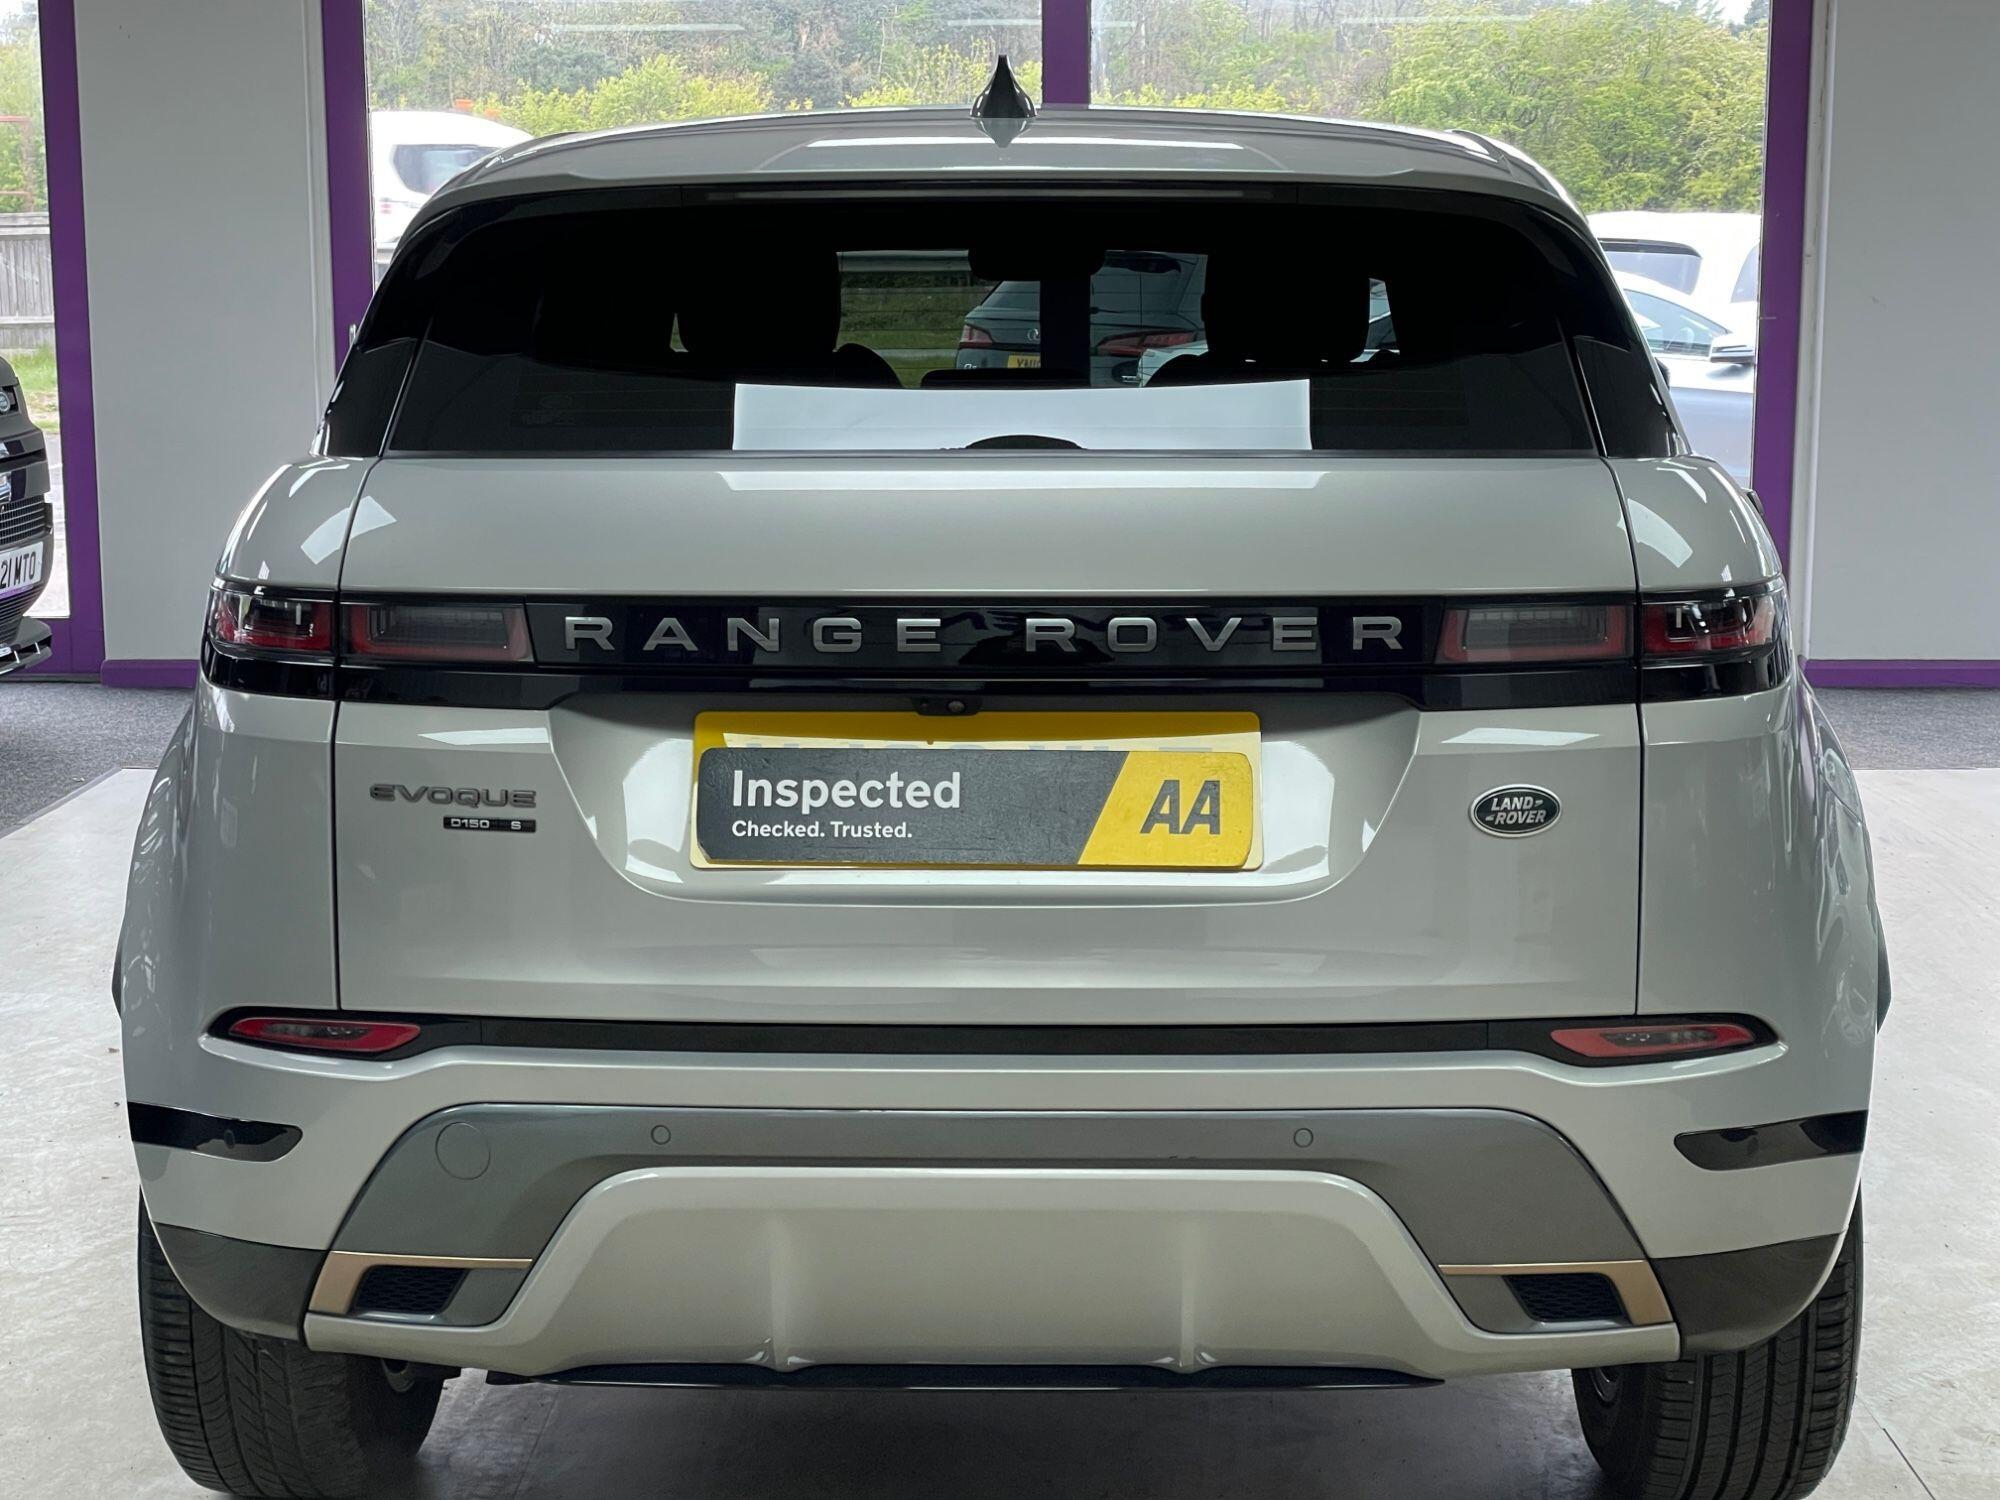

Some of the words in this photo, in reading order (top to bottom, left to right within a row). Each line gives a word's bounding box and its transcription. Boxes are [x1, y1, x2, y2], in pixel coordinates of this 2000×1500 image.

[13, 551, 36, 585] MTO
[565, 616, 942, 653] RANGE
[1025, 616, 1403, 653] ROVER
[369, 783, 537, 809] EVOQUE
[732, 769, 961, 815] Inspected
[1491, 797, 1533, 811] LAND
[1140, 780, 1221, 836] AA
[1494, 810, 1546, 824] ROVER
[450, 818, 490, 829] D150
[510, 820, 522, 830] S
[731, 820, 826, 838] Checked.
[830, 821, 913, 839] Trusted.
